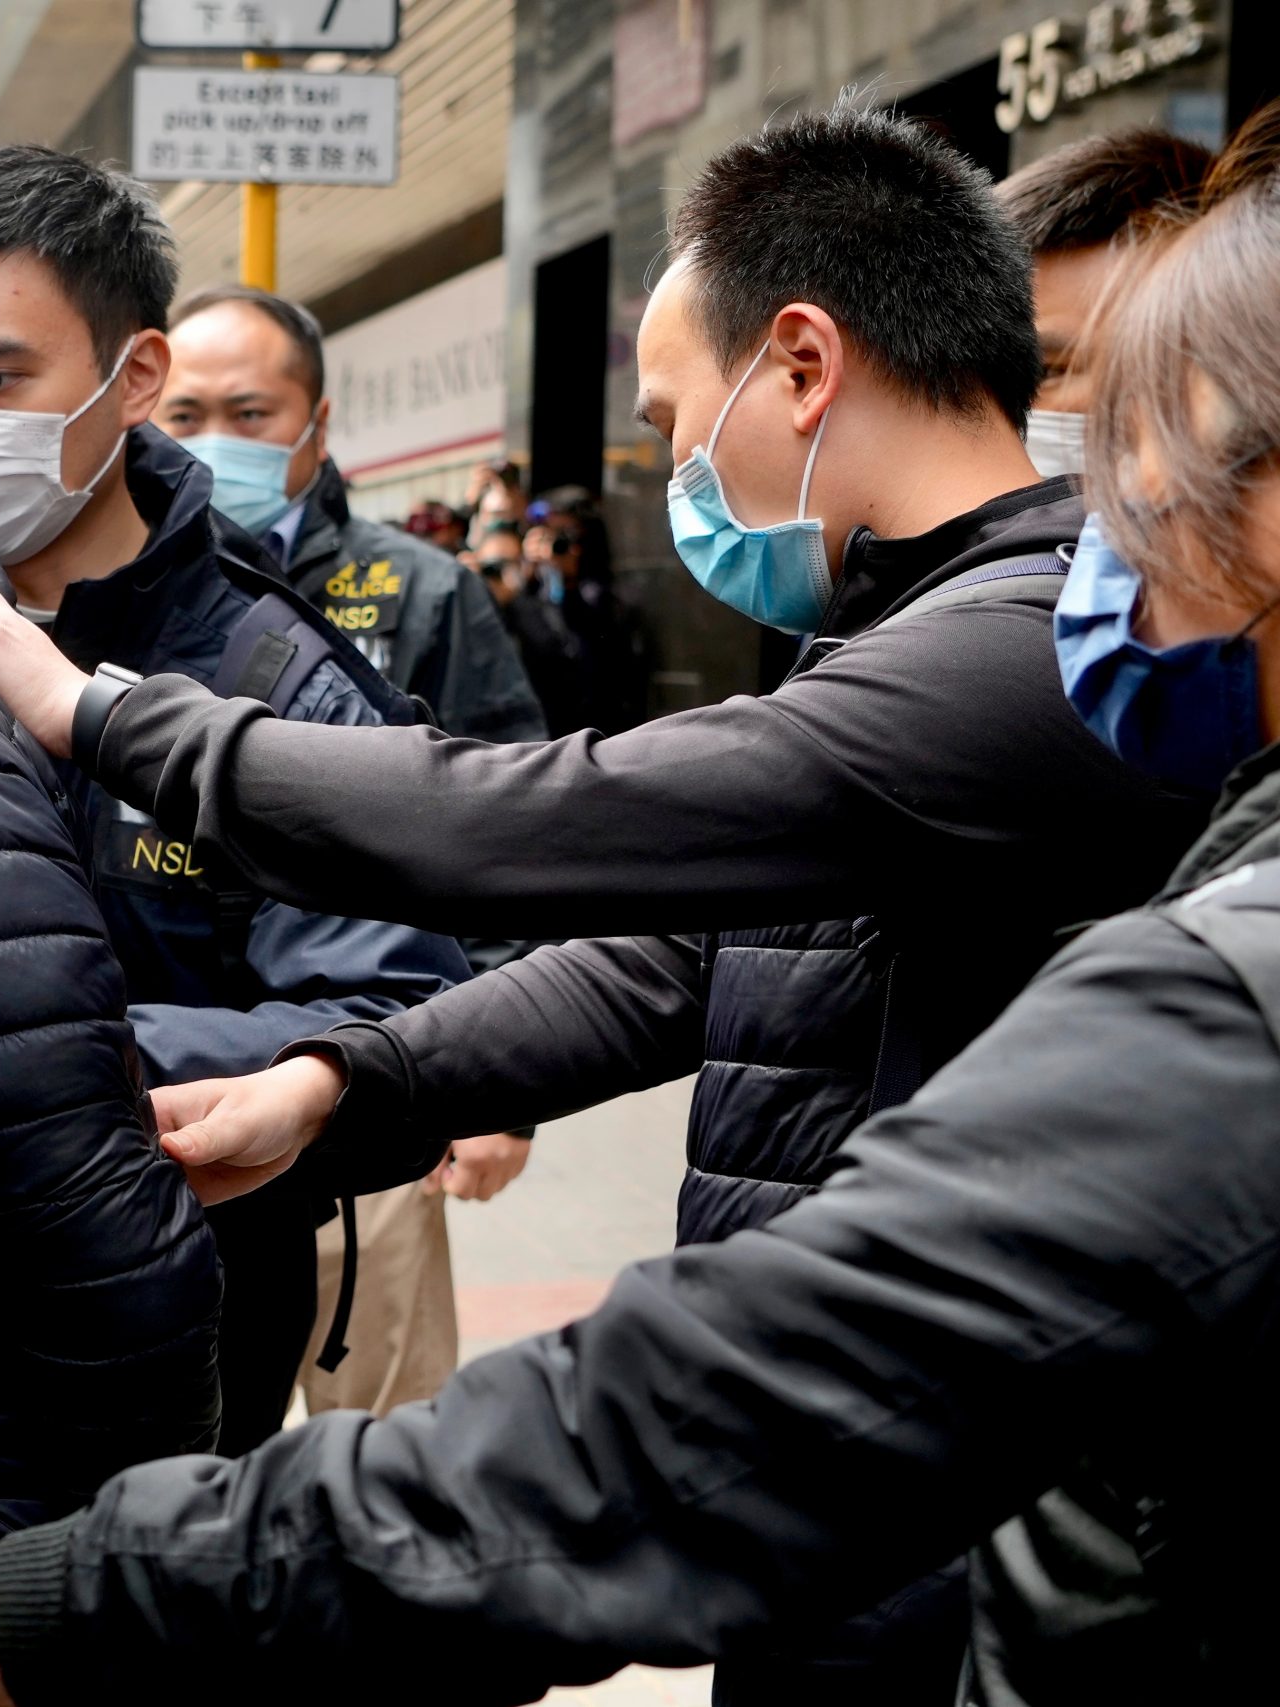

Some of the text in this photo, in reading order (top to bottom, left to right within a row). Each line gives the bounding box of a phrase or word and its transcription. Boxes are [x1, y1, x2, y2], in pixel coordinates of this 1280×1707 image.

[995, 16, 1060, 133] 55
[197, 82, 340, 107] Except taxi
[163, 111, 215, 132] pick
[331, 111, 369, 132] off
[325, 575, 401, 599] OLICE
[324, 603, 379, 630] NSD
